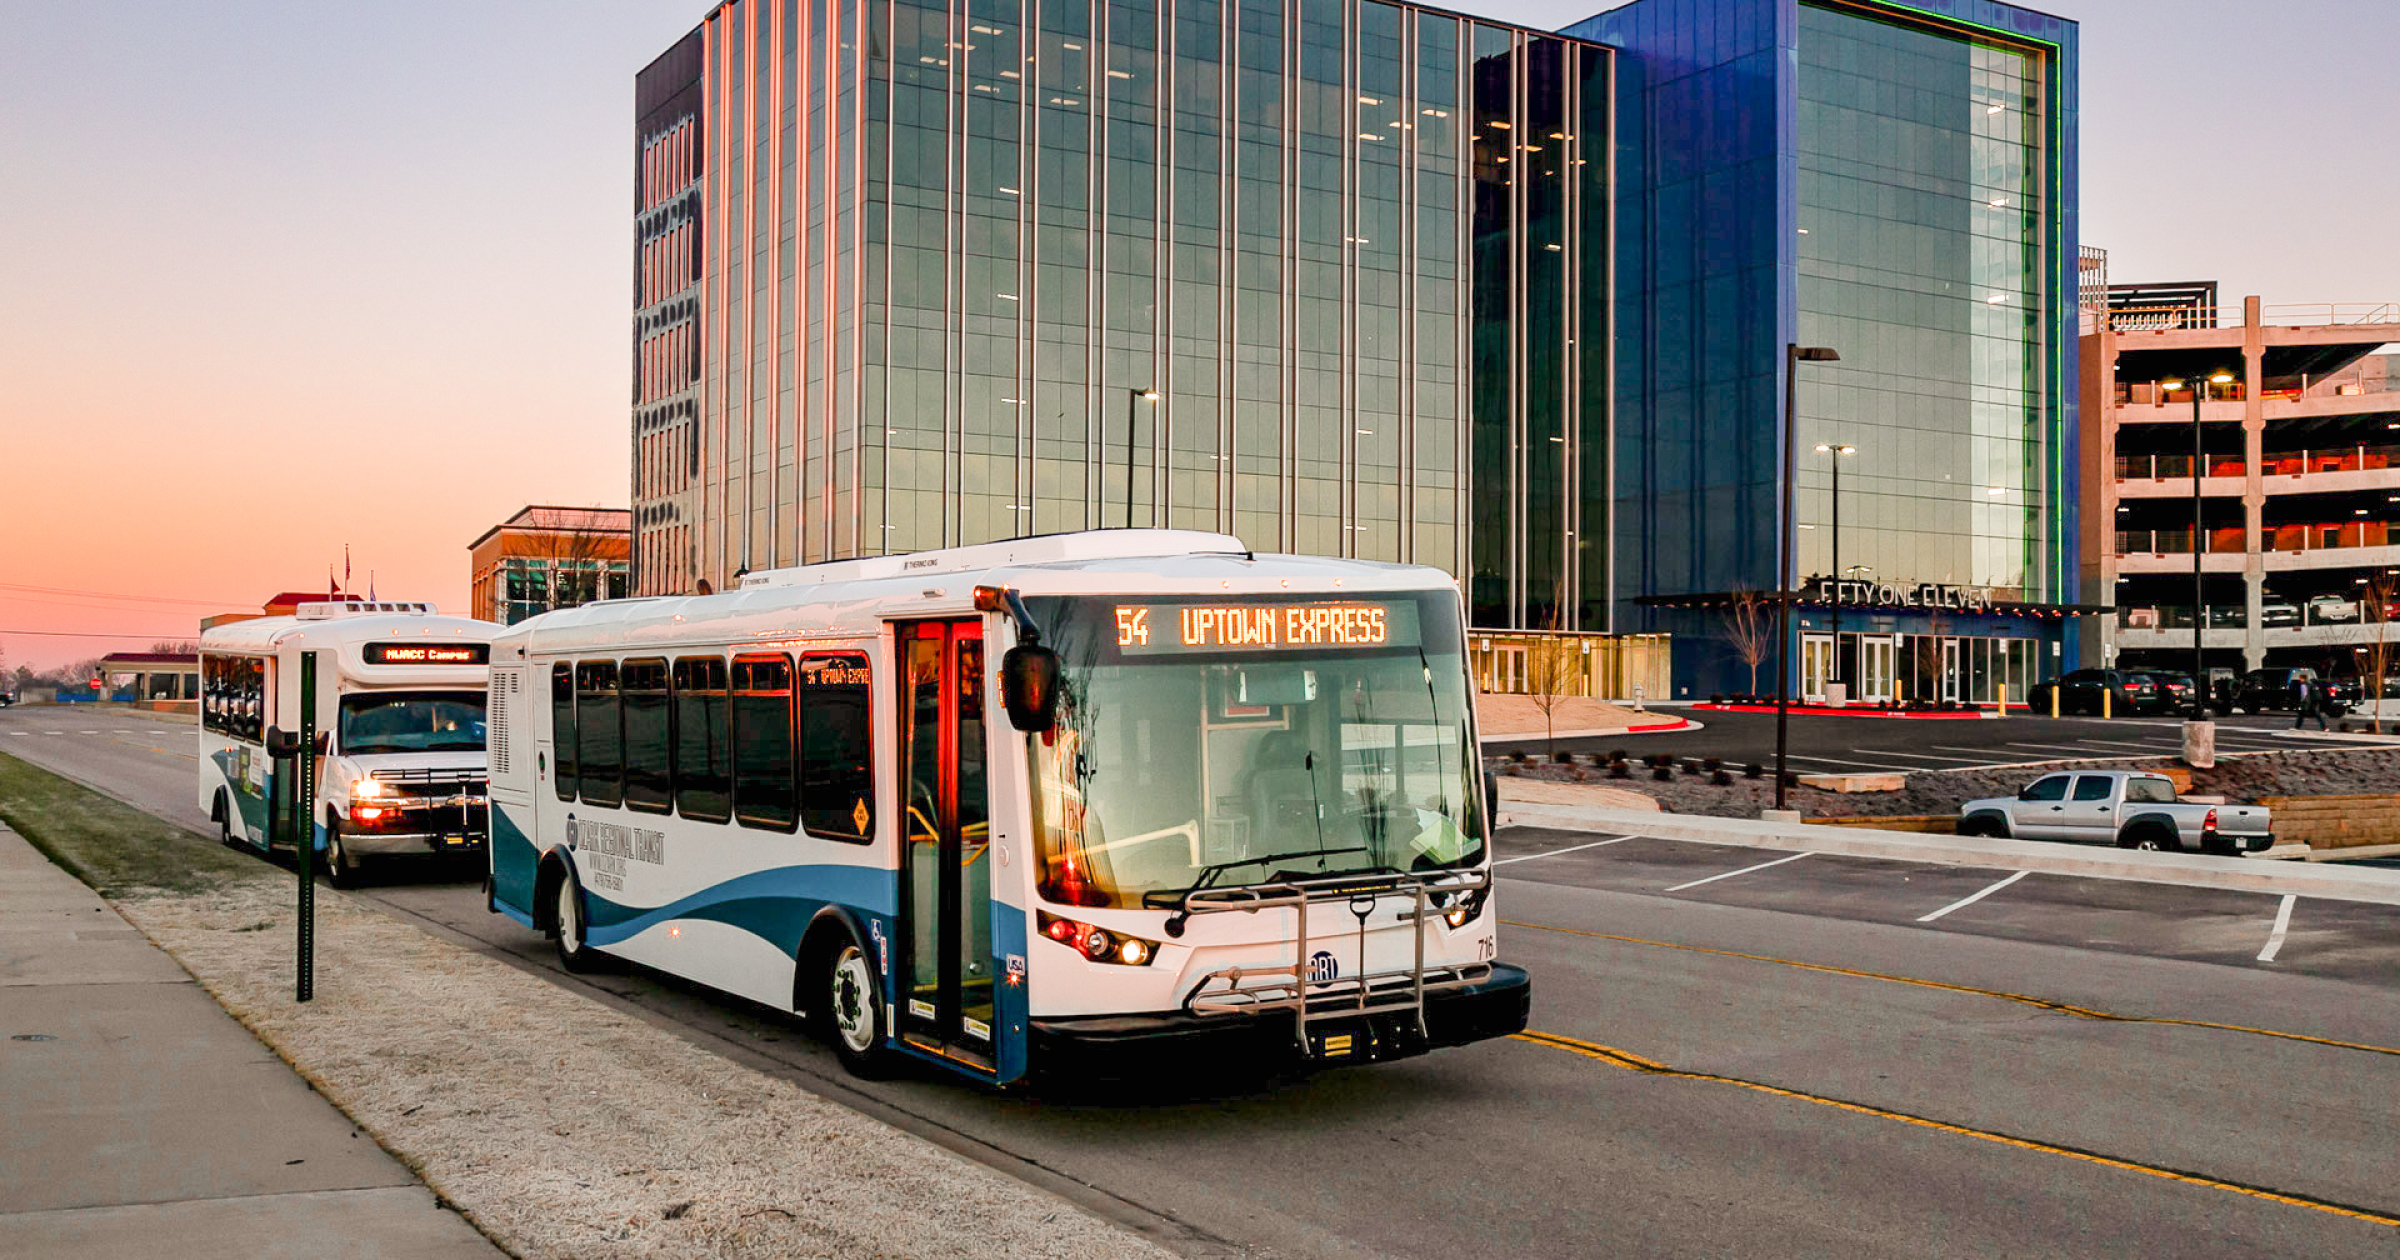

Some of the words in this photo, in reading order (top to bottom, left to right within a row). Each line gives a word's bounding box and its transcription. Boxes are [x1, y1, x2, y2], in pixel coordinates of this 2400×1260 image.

[1820, 581, 1875, 604] FFTY
[1879, 585, 1918, 606] ONE
[1922, 586, 1991, 609] ELEVEN
[1114, 608, 1148, 645] 54
[1182, 608, 1277, 645] UPTOWN
[1286, 607, 1386, 644] EXPRESS
[634, 828, 665, 866] TRANSIT
[1478, 934, 1493, 960] 716
[1008, 957, 1023, 971] USA
